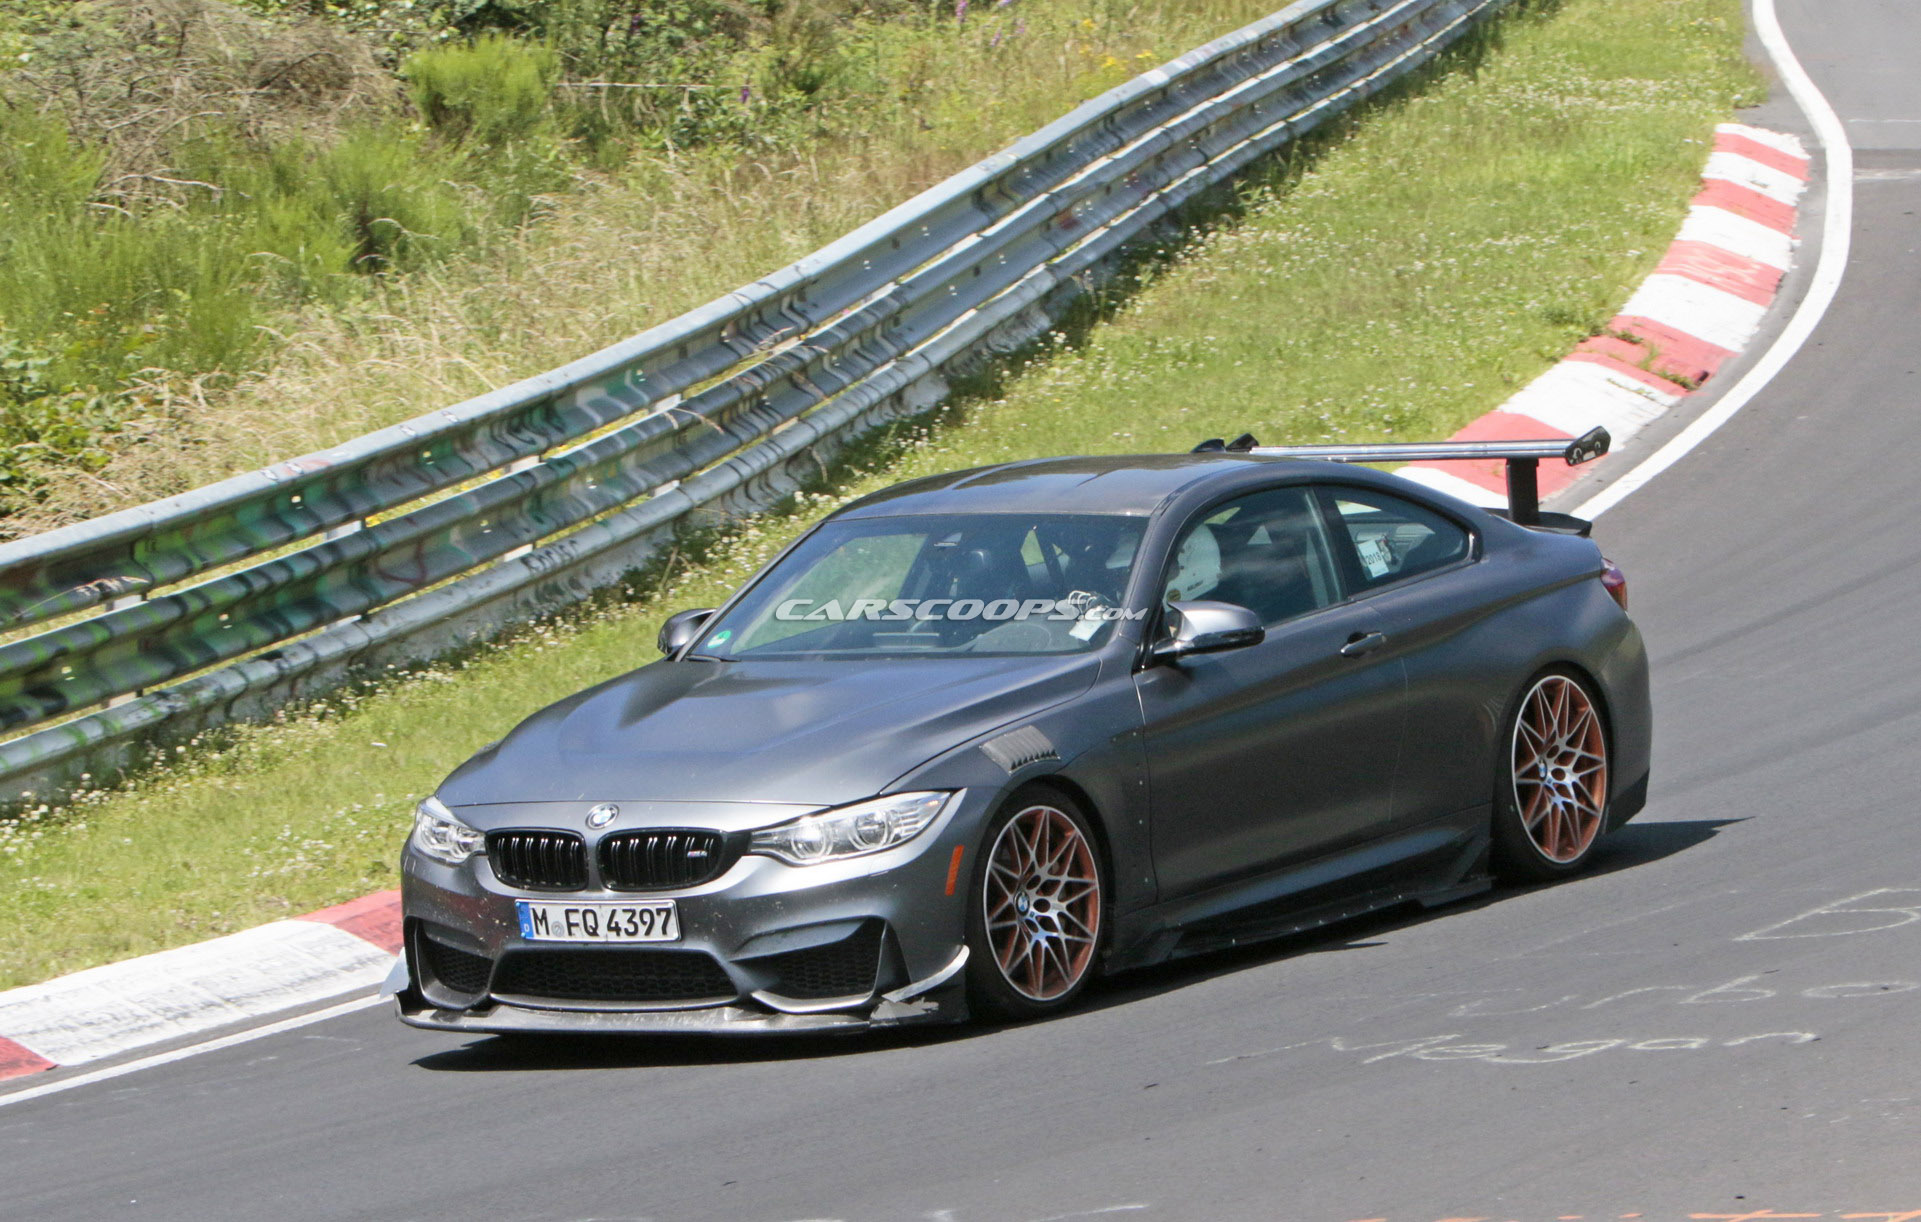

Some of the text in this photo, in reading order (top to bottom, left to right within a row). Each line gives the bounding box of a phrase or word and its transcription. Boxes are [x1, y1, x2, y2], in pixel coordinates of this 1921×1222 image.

[531, 907, 672, 937] M FQ 4397
